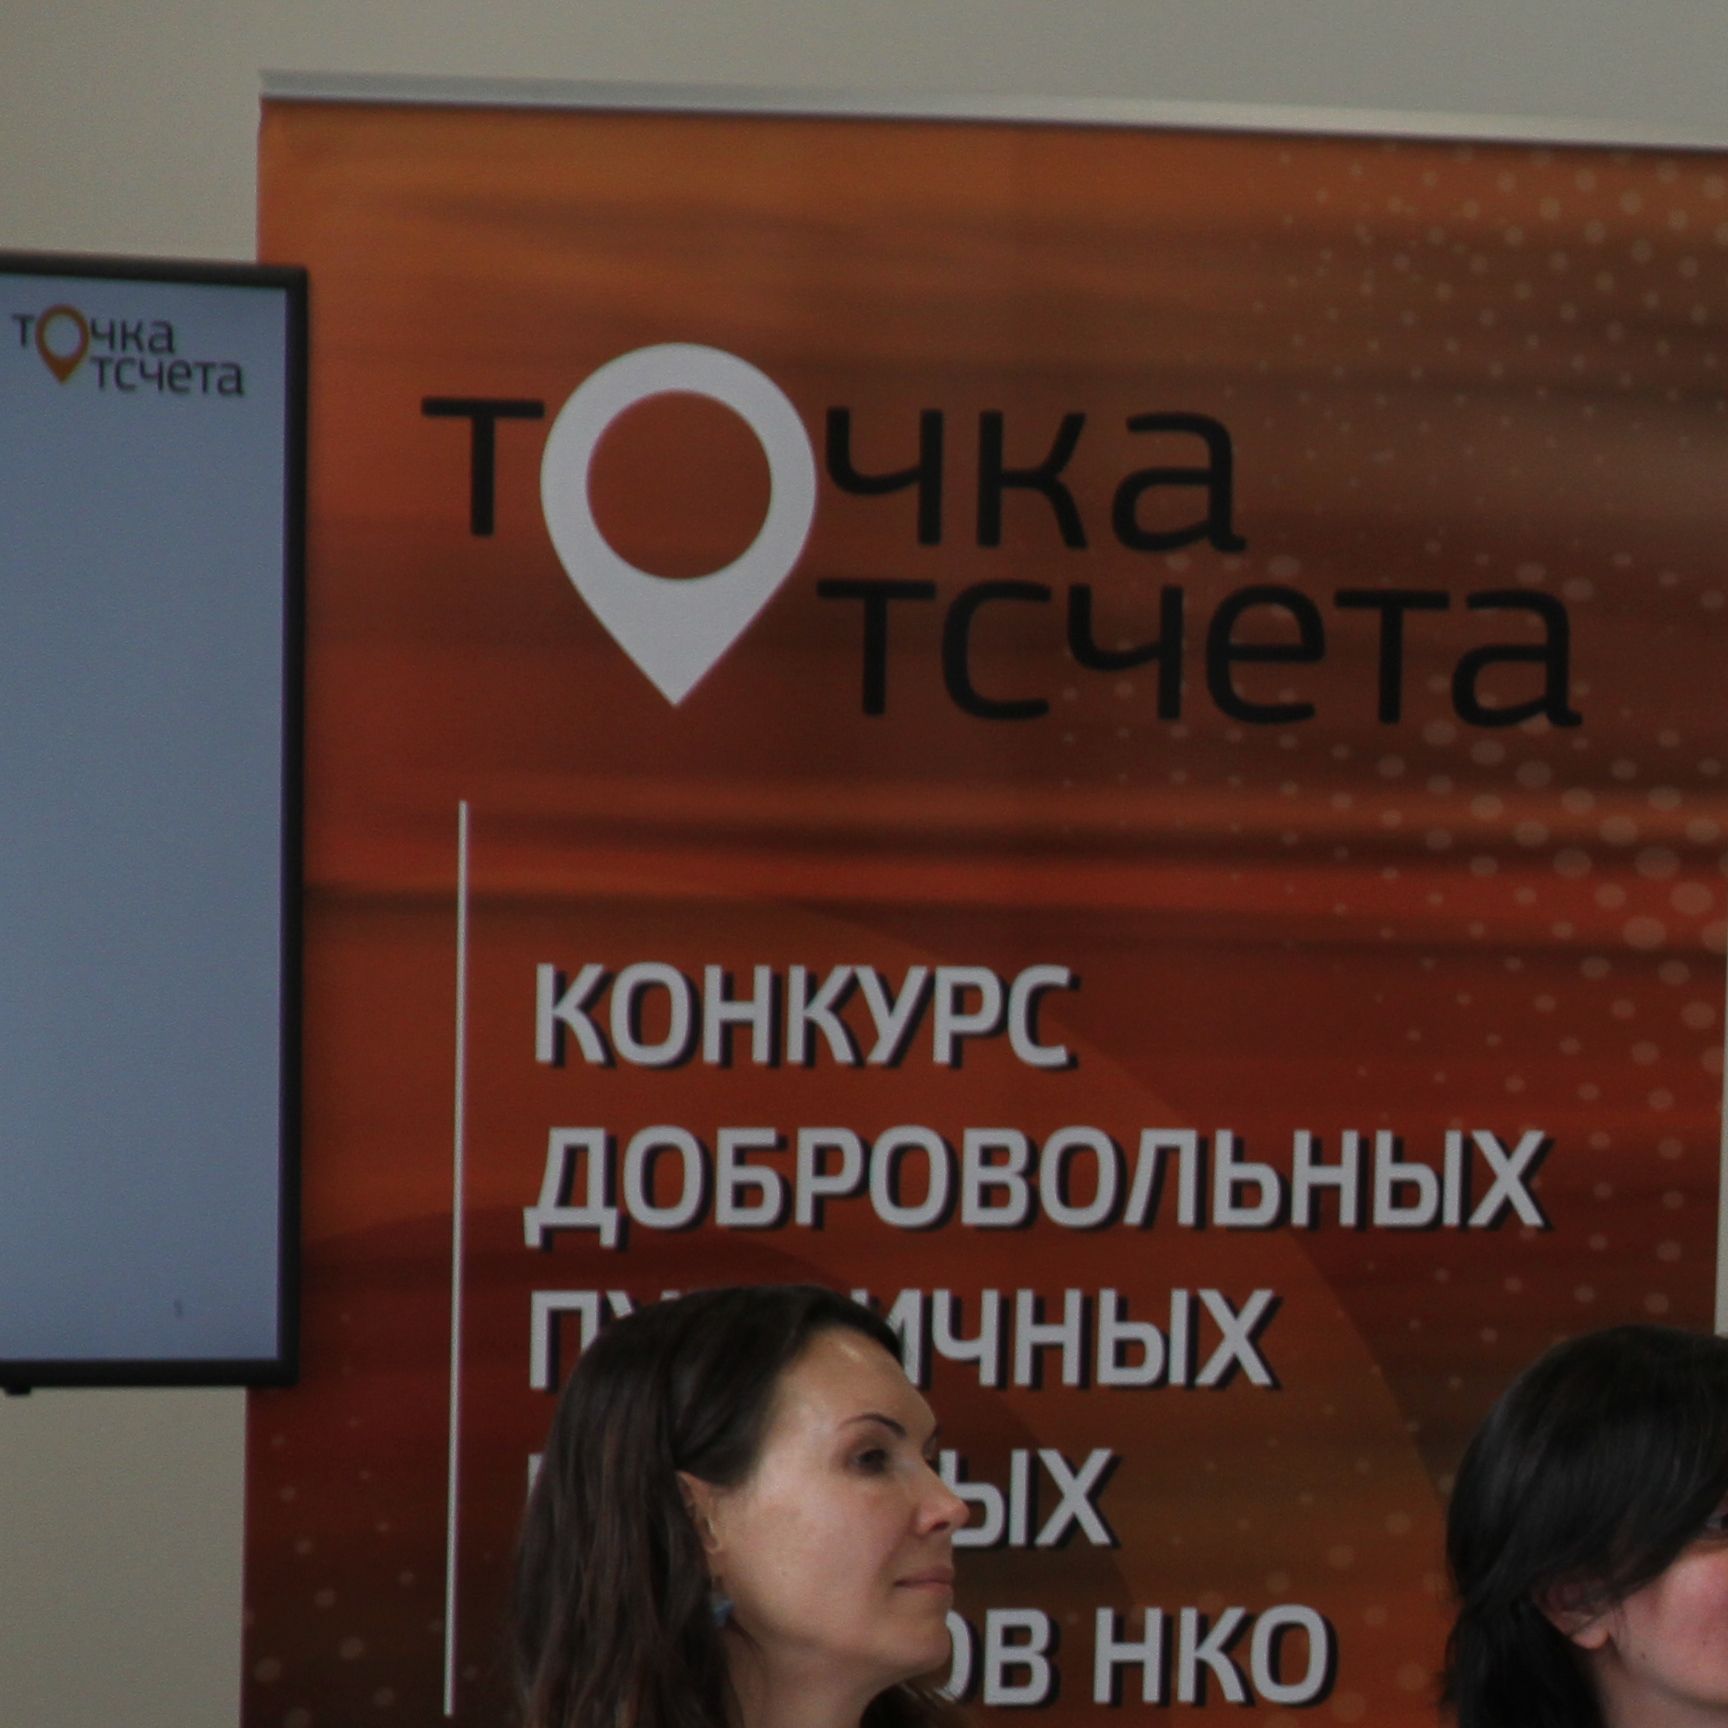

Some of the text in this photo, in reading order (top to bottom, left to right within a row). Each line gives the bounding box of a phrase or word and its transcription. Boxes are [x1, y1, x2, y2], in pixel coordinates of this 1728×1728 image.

[534, 962, 1078, 1068] КОНКУРС
[522, 1125, 1546, 1250] ДОБРОВОЛЬНЫХ
[529, 1288, 1275, 1390] ПИЧНЫХ
[1093, 1605, 1333, 1706] НКО
